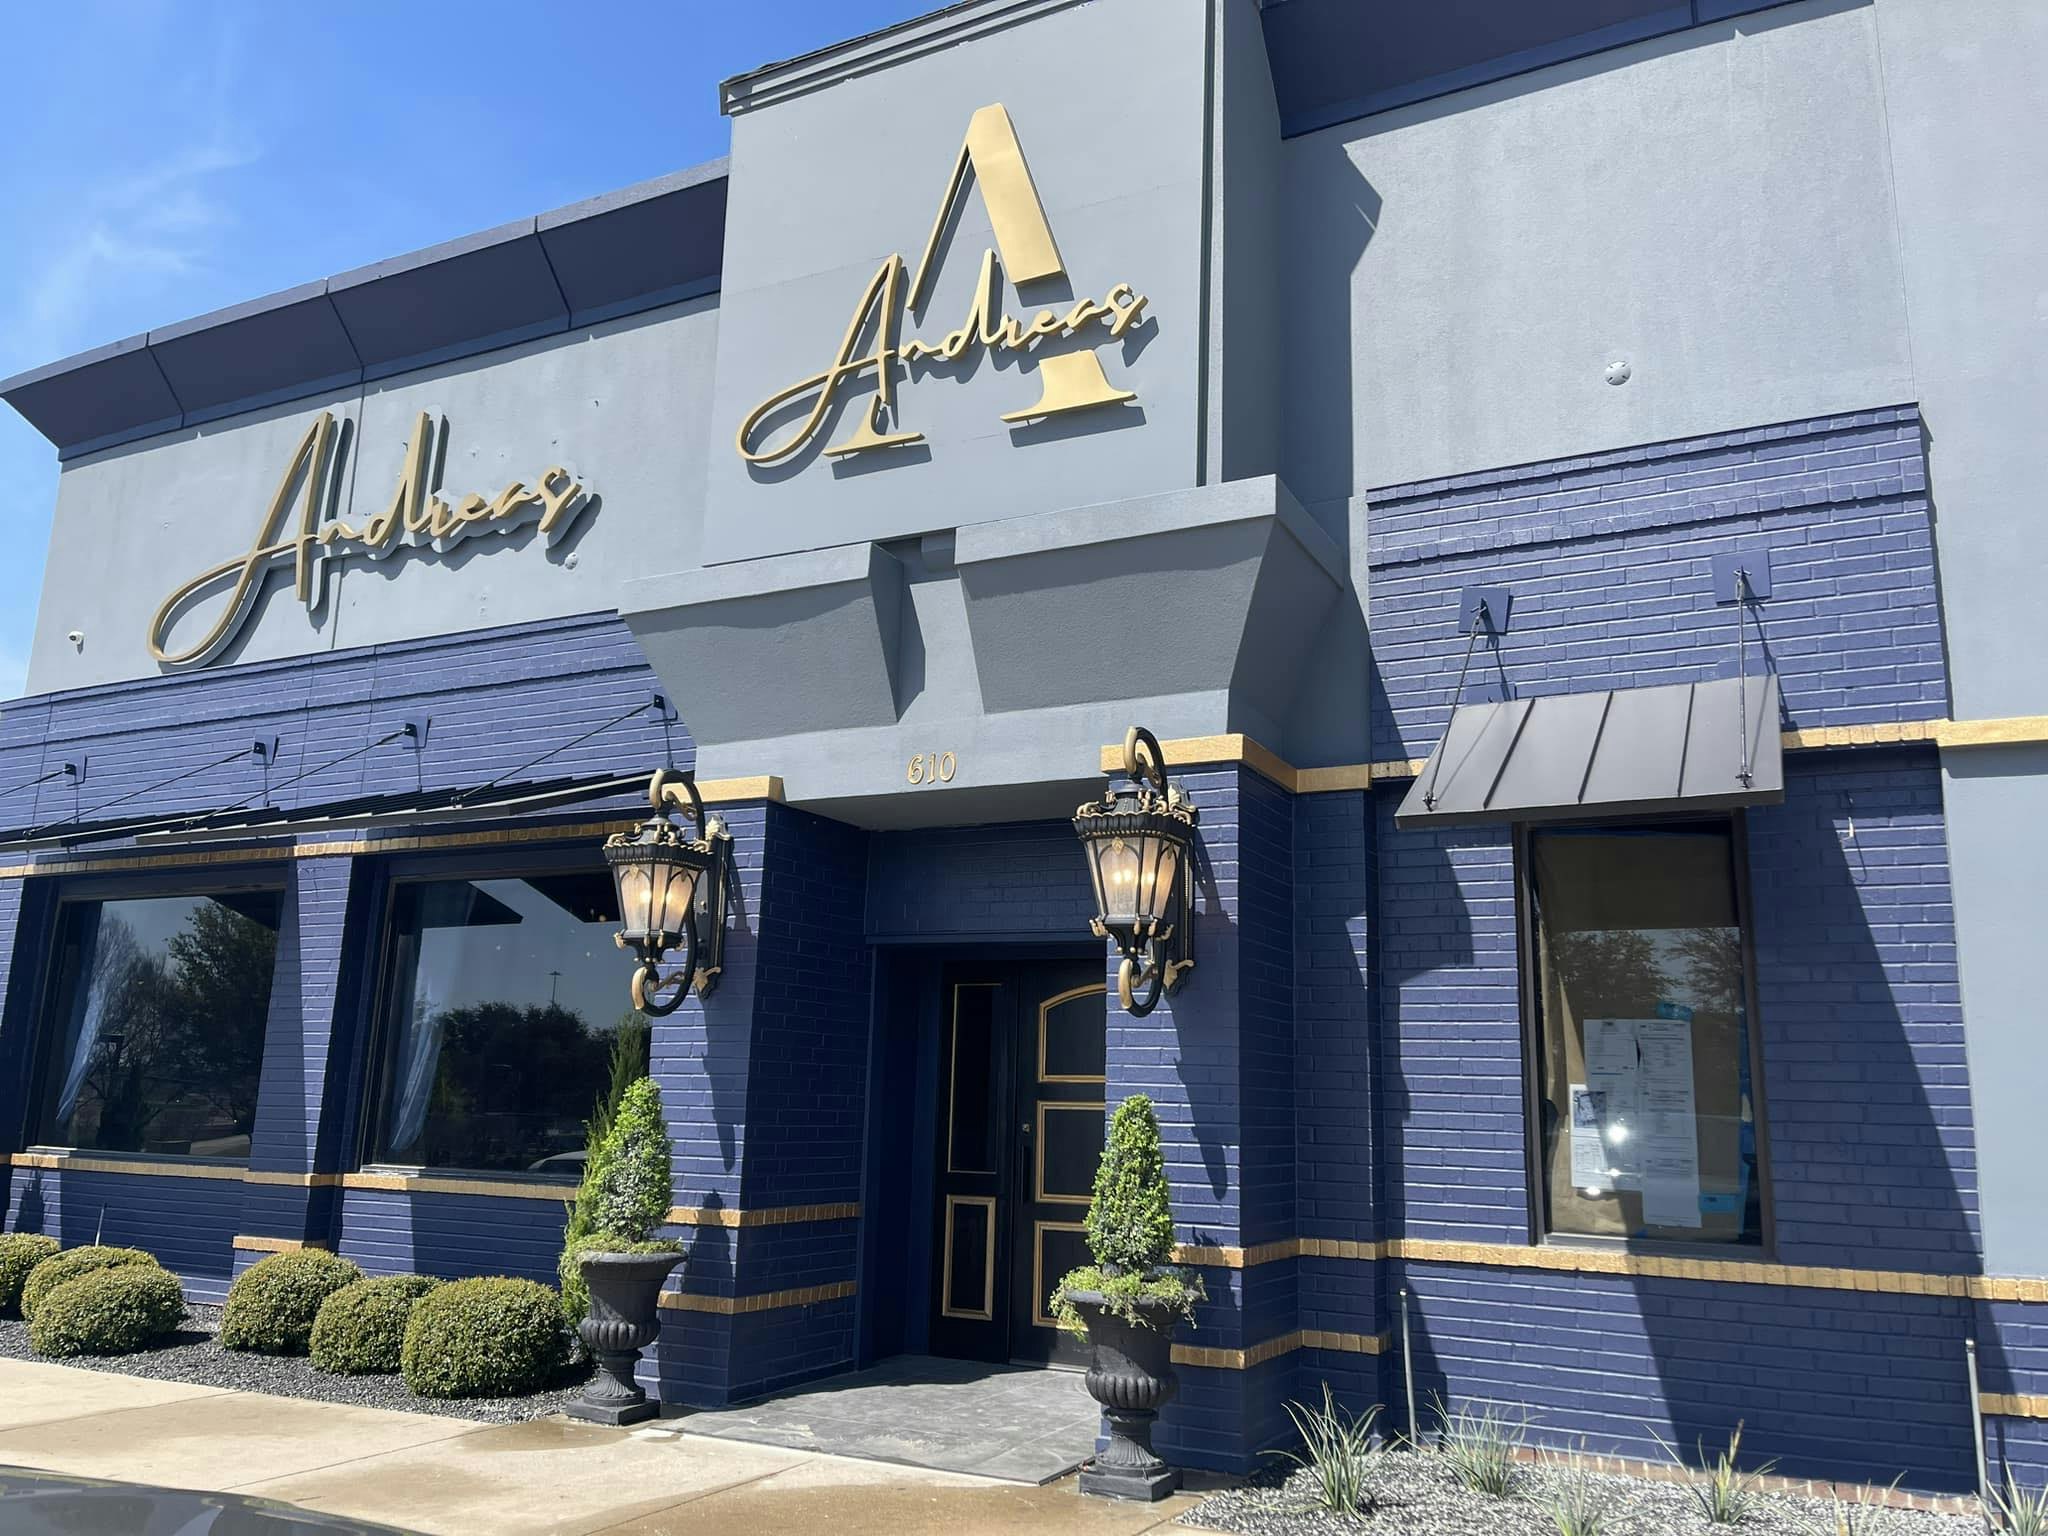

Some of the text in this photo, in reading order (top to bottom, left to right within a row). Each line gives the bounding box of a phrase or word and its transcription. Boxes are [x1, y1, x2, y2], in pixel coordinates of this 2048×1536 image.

[735, 248, 1148, 461] Andreas
[824, 102, 1137, 457] A
[147, 410, 583, 664] Andreas
[907, 751, 957, 785] 610
